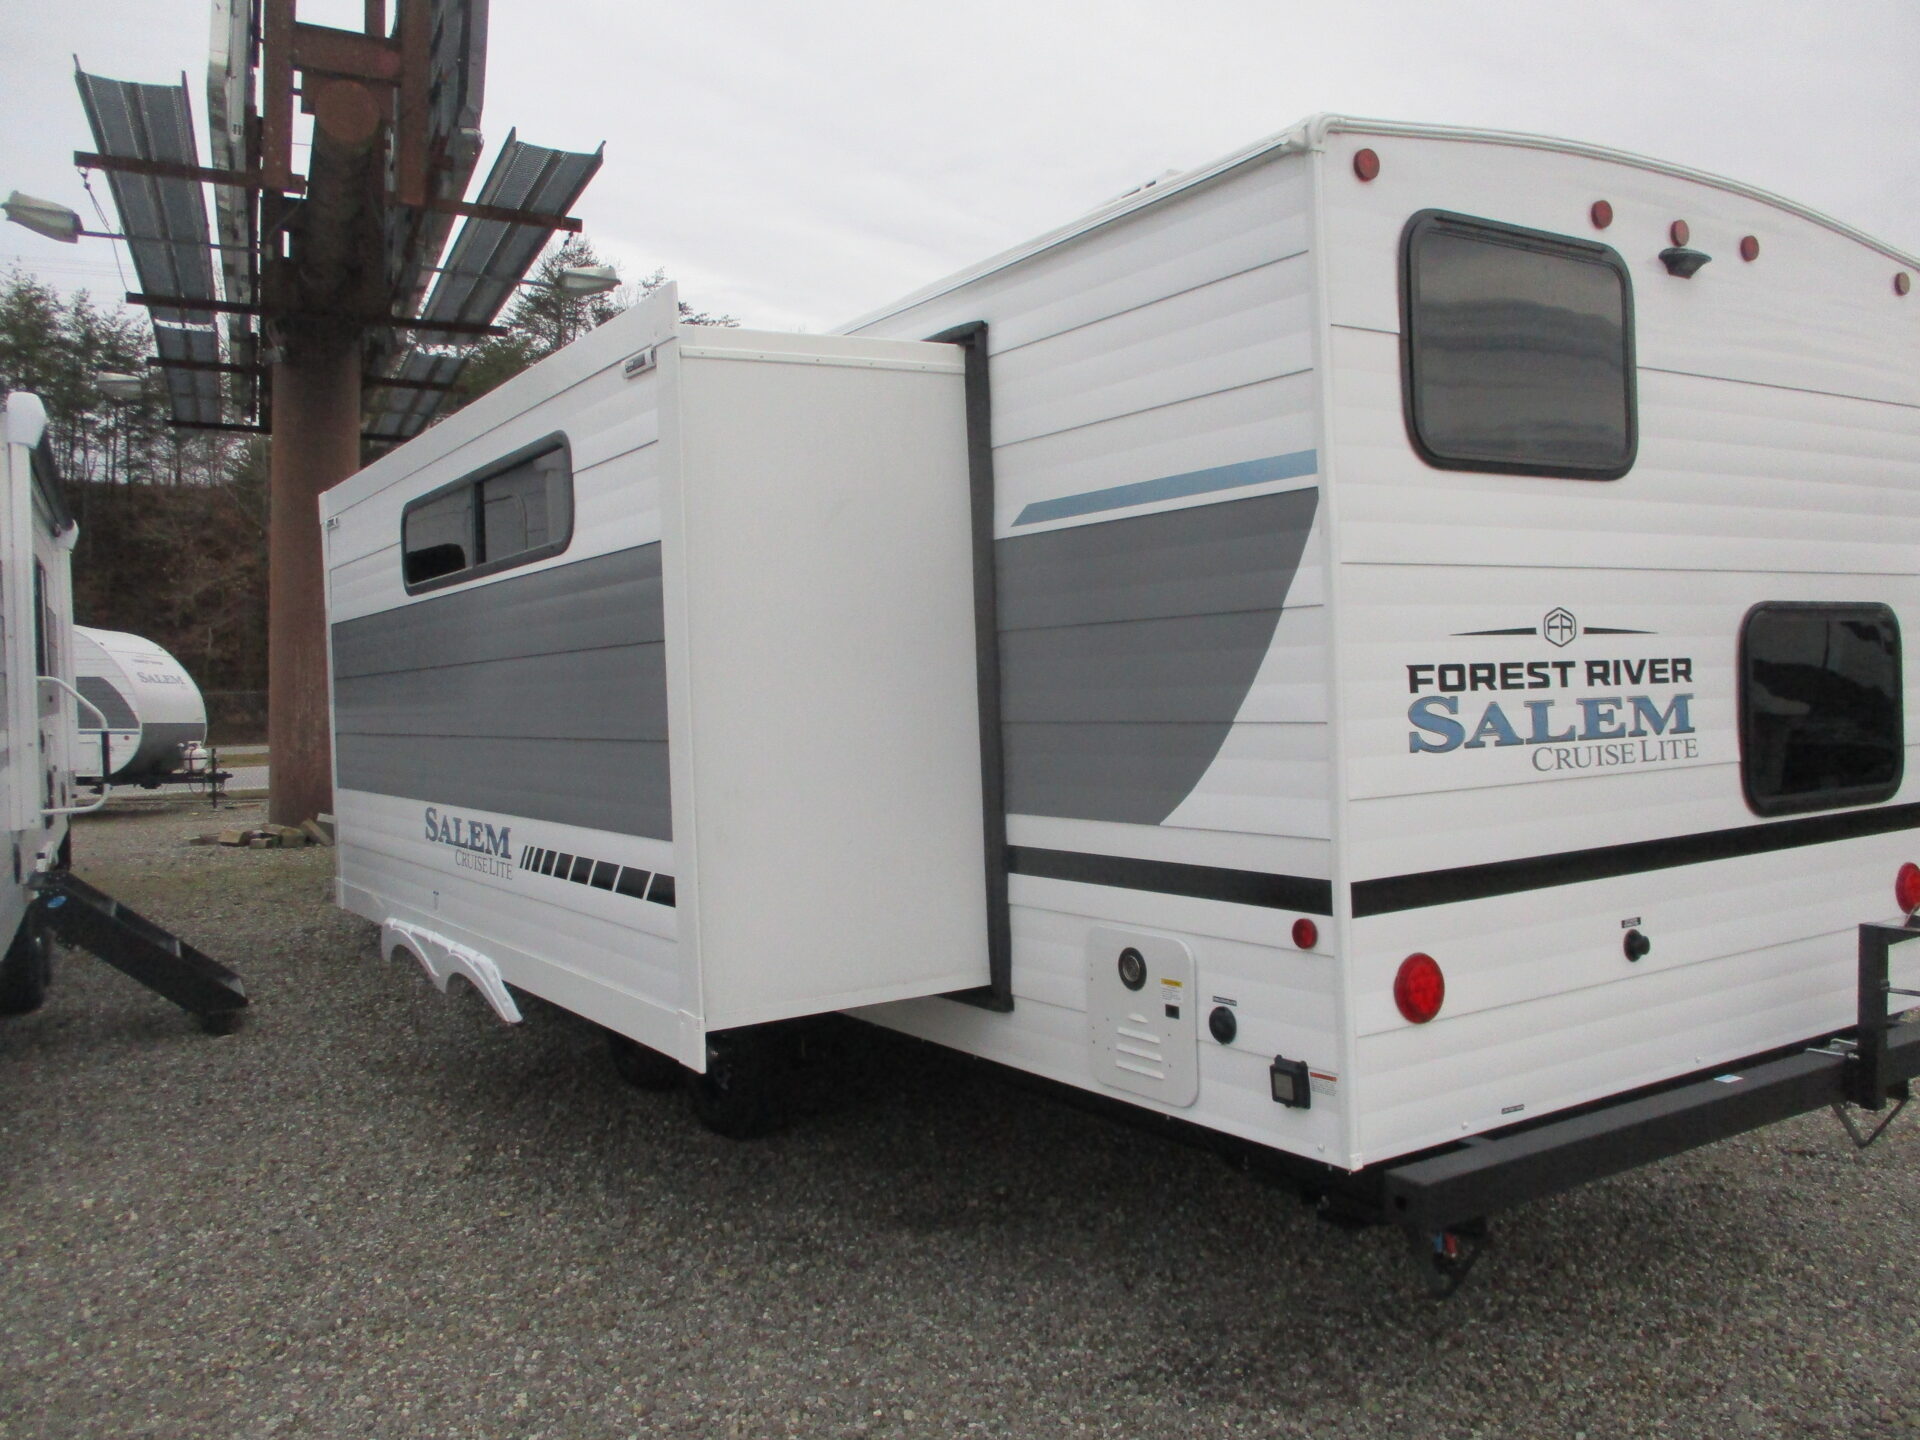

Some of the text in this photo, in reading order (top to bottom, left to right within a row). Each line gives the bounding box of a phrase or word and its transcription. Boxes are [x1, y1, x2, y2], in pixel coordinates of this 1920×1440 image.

[1406, 657, 1693, 694] FOREST RIVER
[1407, 692, 1696, 754] SALEM
[424, 806, 512, 860] SALEM
